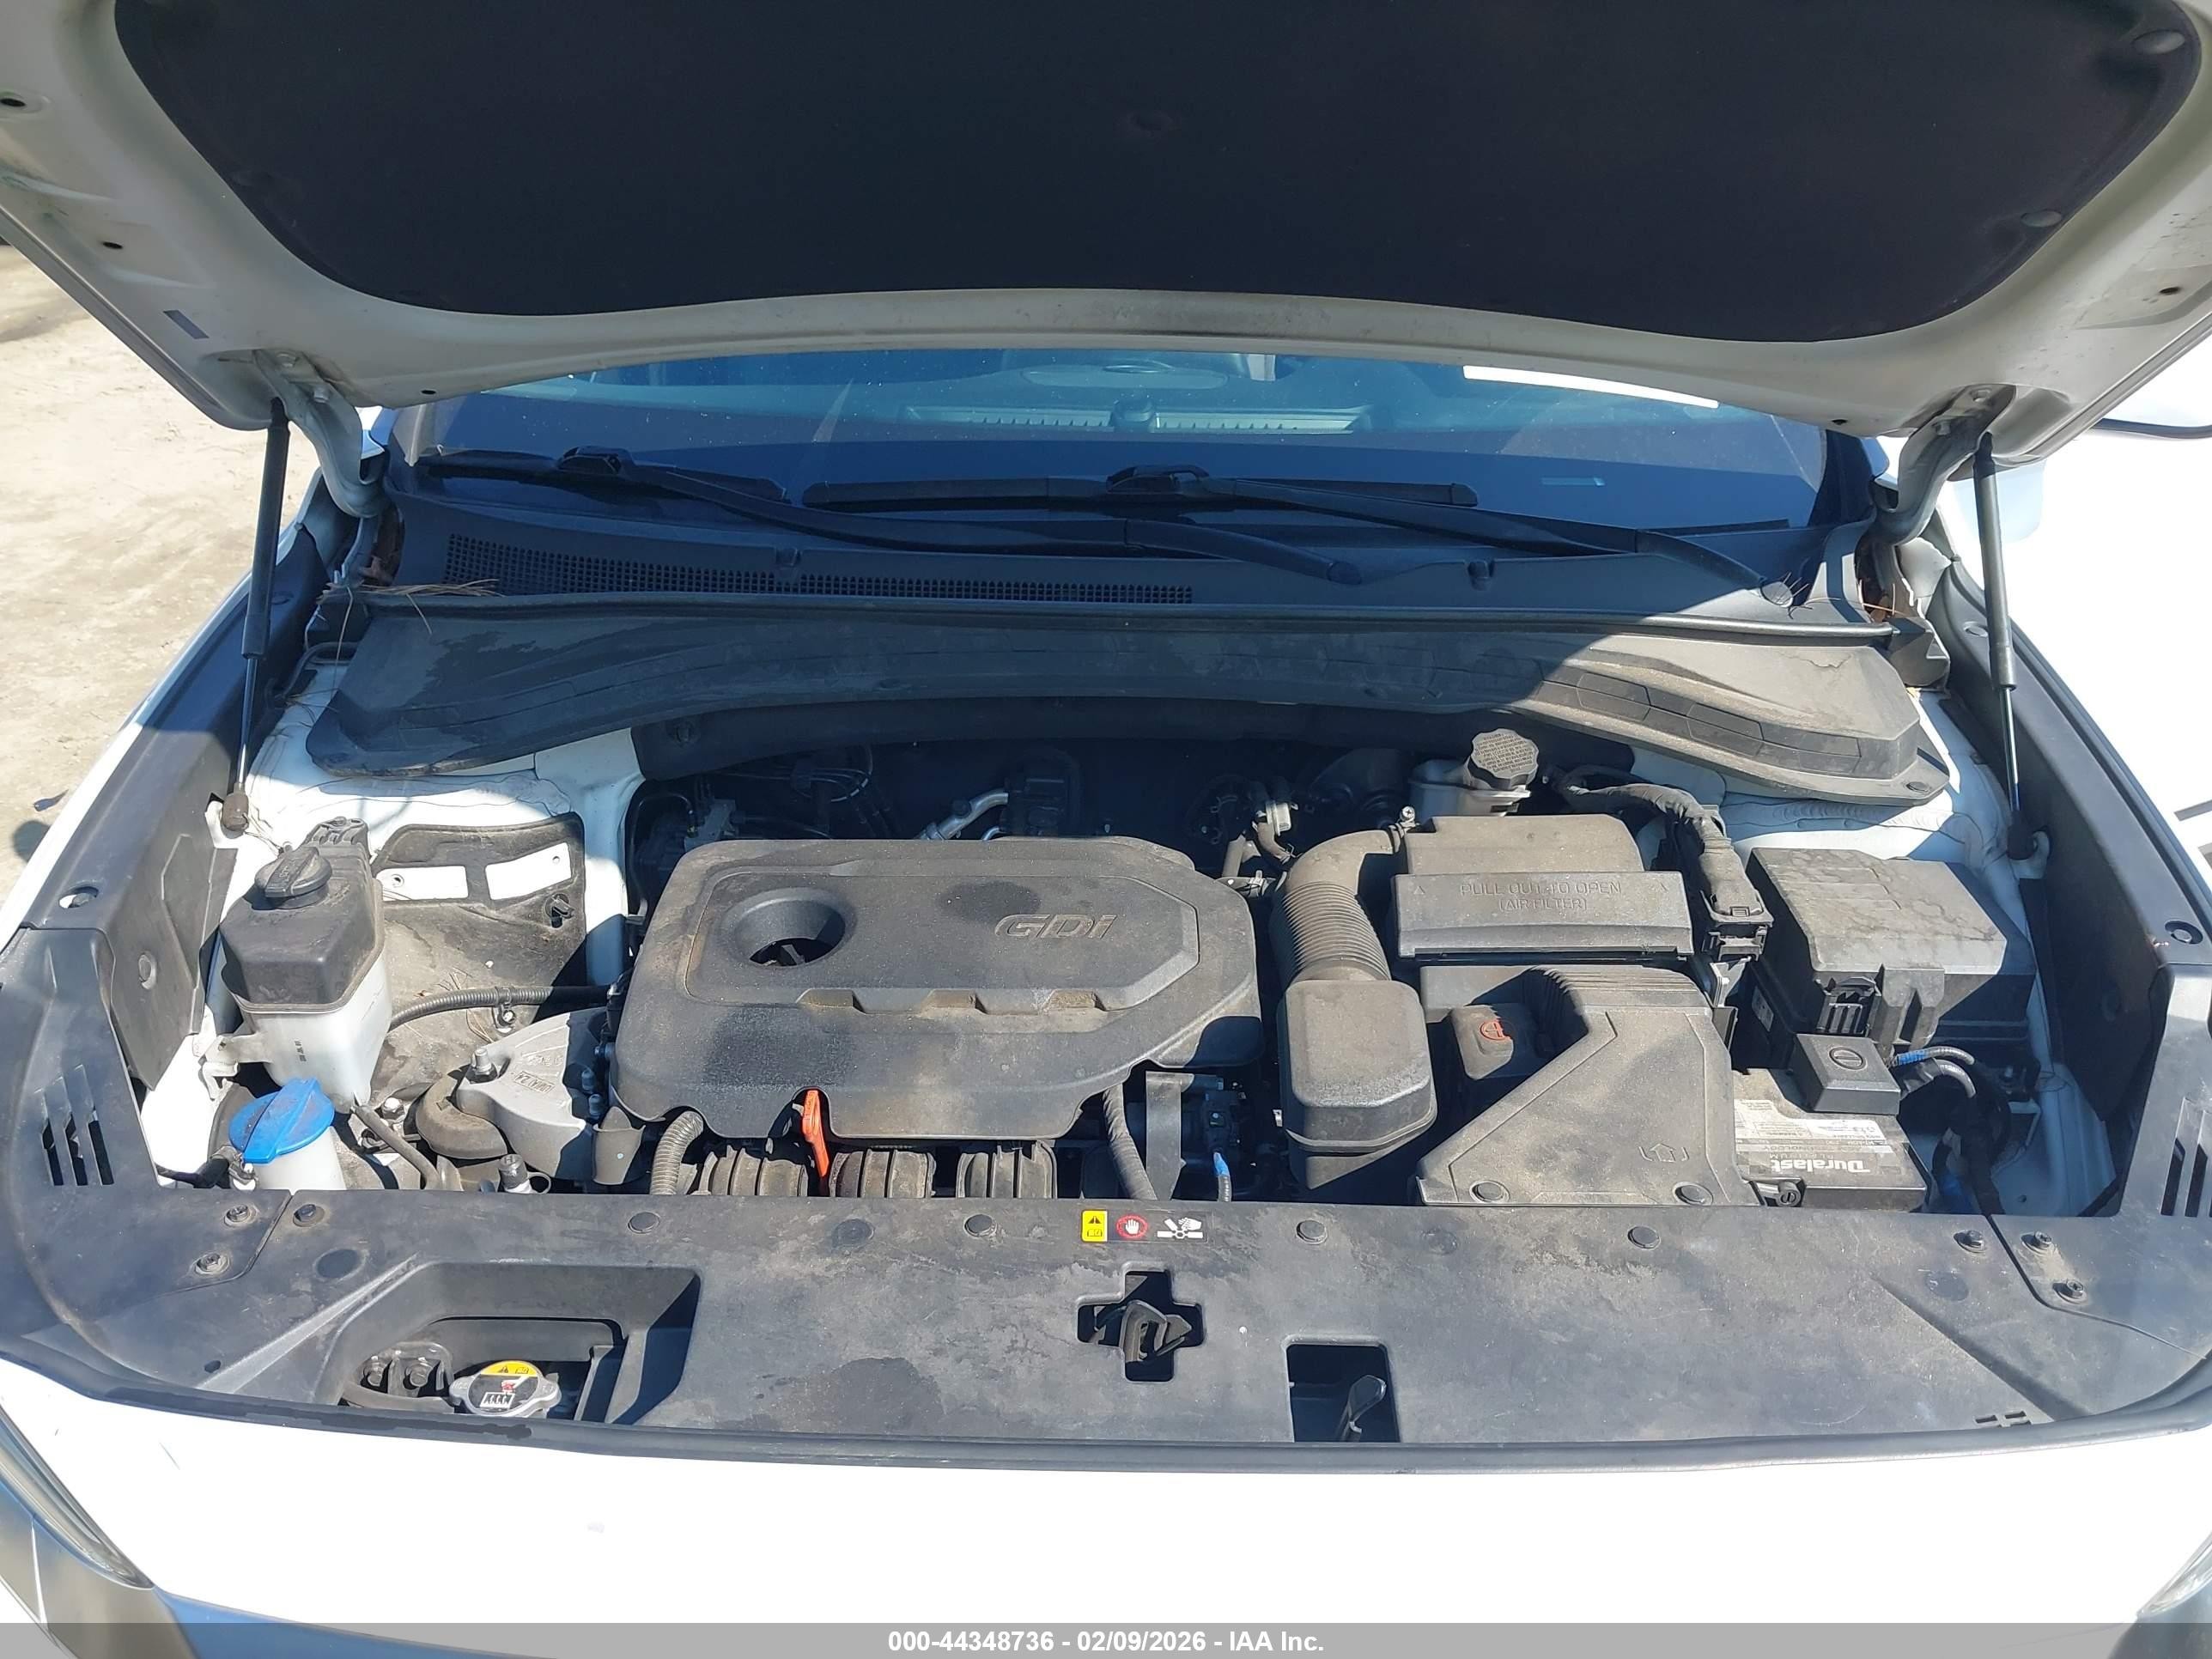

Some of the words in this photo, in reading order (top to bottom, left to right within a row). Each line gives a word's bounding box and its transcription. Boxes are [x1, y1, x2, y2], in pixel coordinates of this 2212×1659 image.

[1460, 882, 1504, 896] PULL
[1509, 882, 1541, 896] OUT
[1550, 881, 1571, 896] TO
[1575, 880, 1622, 895] OPEN
[1498, 898, 1529, 911] (AIR
[1531, 897, 1588, 911] FILTER)
[1771, 1159, 1870, 1173] Duralast
